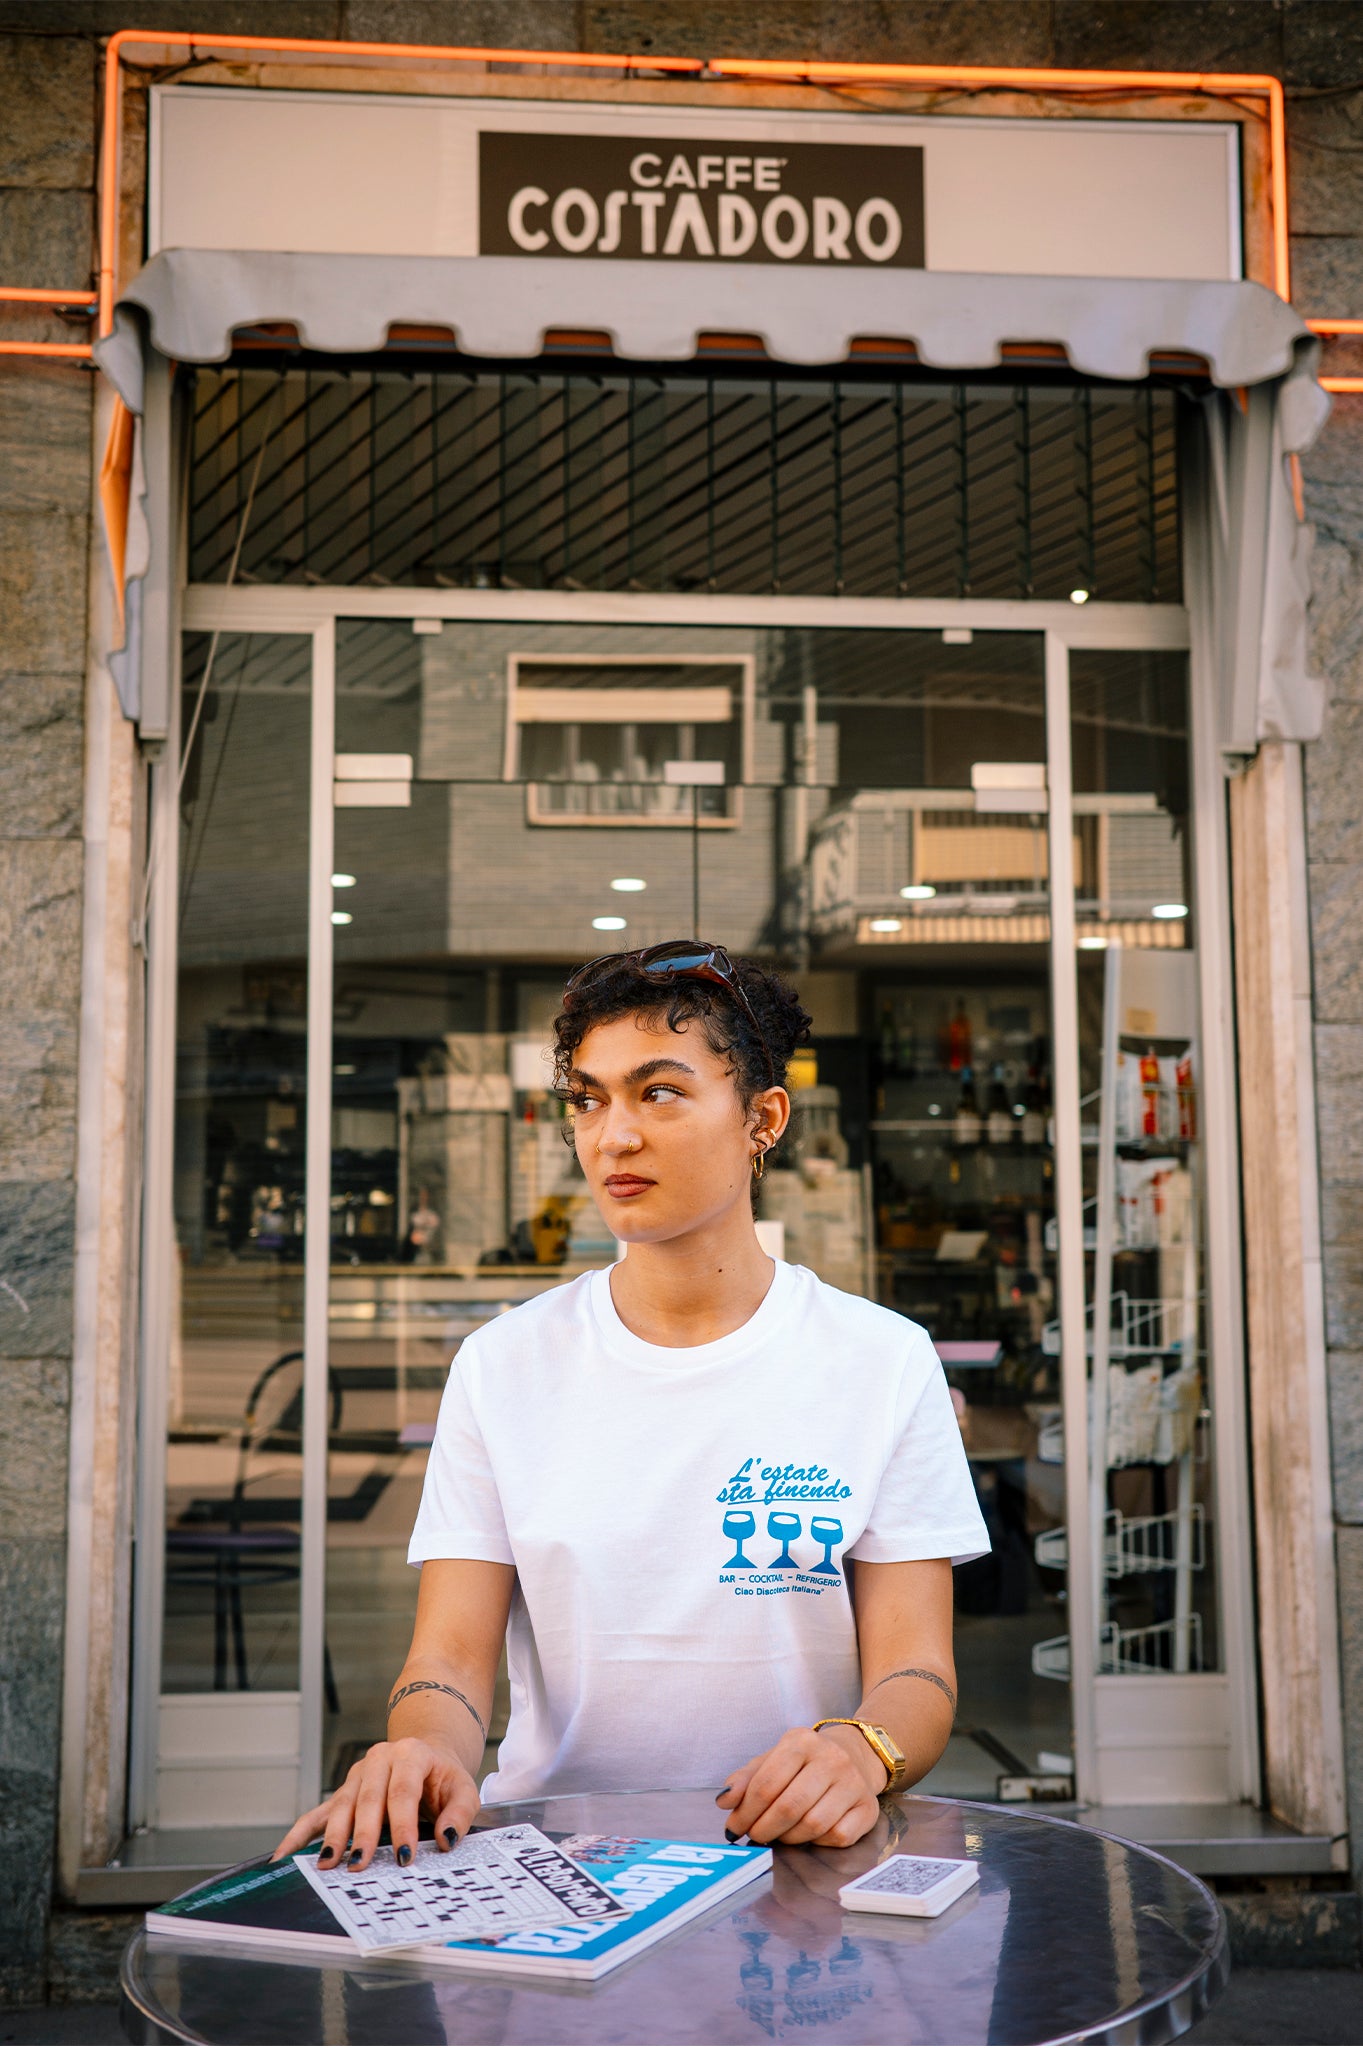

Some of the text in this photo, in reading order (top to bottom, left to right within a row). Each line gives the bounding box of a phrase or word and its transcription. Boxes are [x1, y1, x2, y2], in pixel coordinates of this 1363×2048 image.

[507, 186, 902, 262] COSTADORO
[728, 1457, 830, 1484] L'estate
[716, 1478, 853, 1506] sta finendo
[719, 1574, 736, 1583] BAR
[748, 1573, 784, 1583] COCKTAIL
[795, 1573, 842, 1587] REFRIGERIO
[734, 1587, 754, 1596] Ciao
[756, 1586, 790, 1596] Discoteca
[646, 1843, 752, 1864] la
